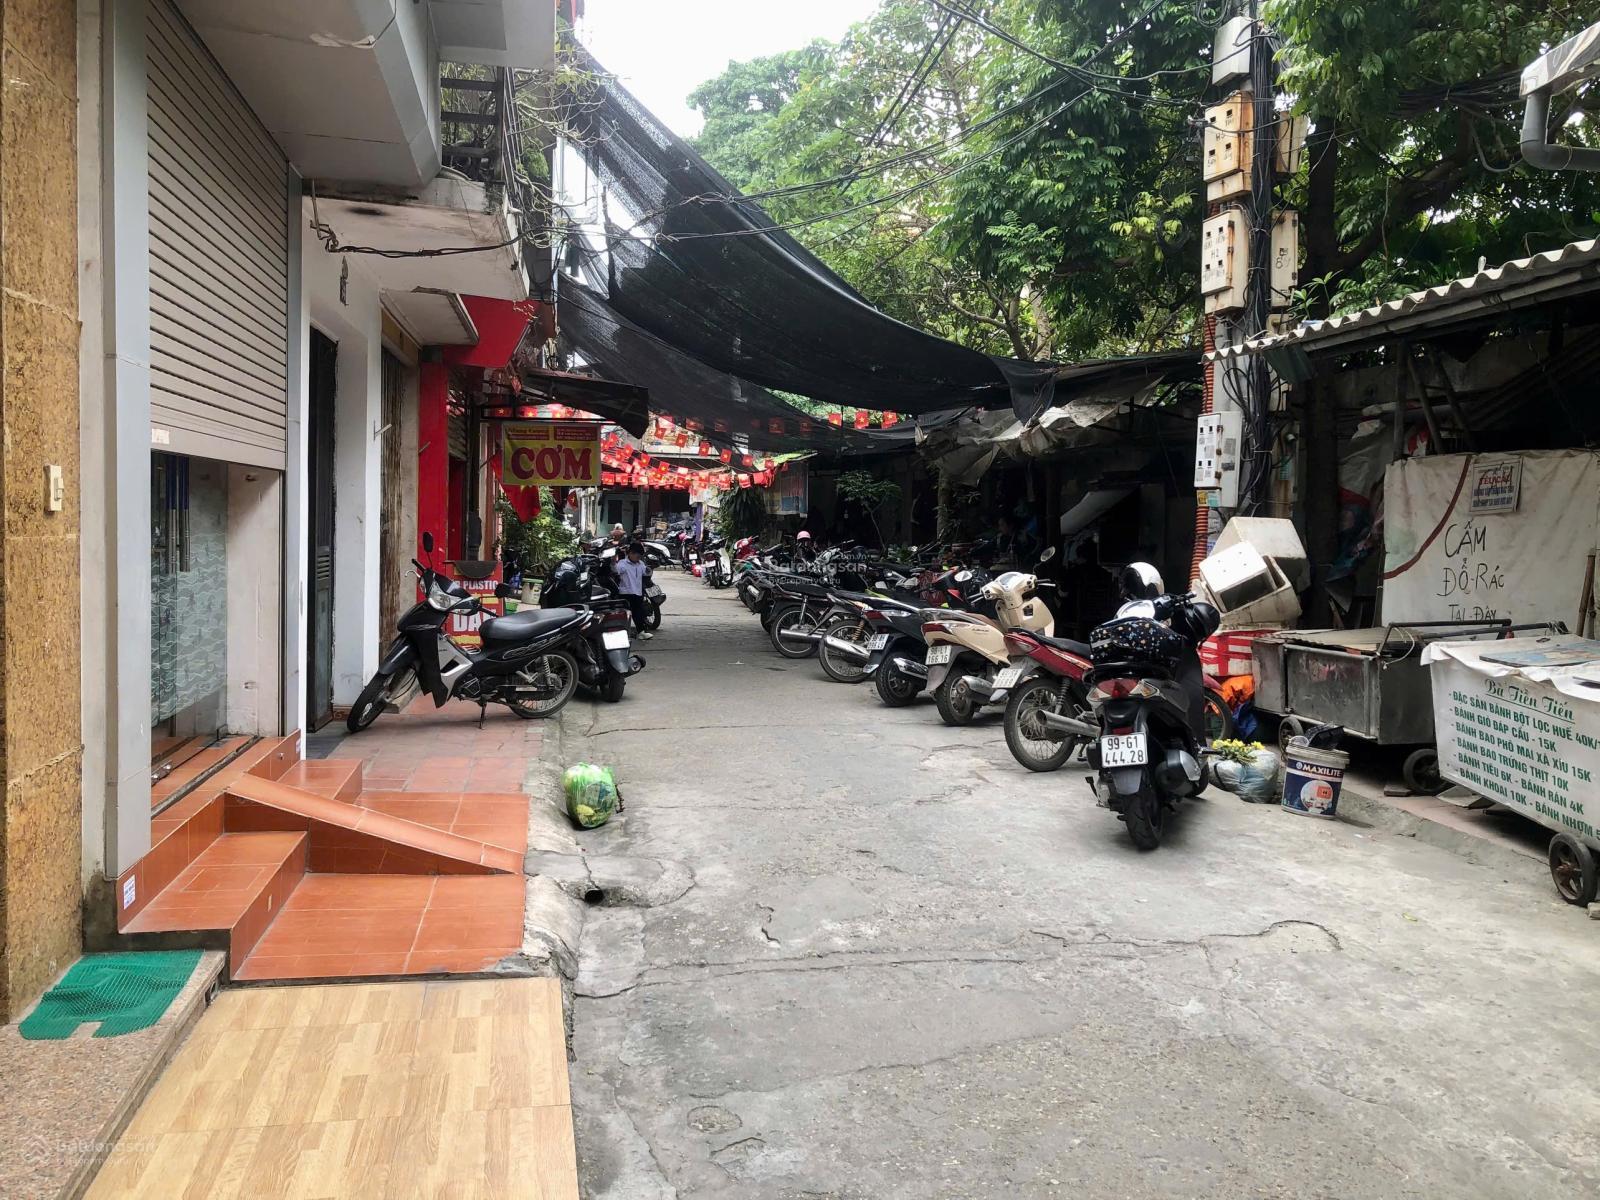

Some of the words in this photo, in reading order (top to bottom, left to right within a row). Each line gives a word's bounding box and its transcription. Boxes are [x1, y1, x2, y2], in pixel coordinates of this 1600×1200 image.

[511, 444, 592, 480] CƠM
[1444, 518, 1487, 558] CẤM
[463, 580, 499, 590] PLASTIC
[1454, 706, 1475, 722] BÁNH
[1538, 737, 1557, 753] 15K
[1489, 702, 1511, 720] BÁNH
[1513, 711, 1530, 727] BỘT
[1532, 718, 1550, 735] LỌC
[1552, 724, 1573, 742] HUẾ
[1104, 750, 1144, 766] 444.28
[1107, 735, 1139, 751] 99-G1
[1456, 721, 1477, 739] BÁNH
[1479, 730, 1496, 745] BAO
[1516, 745, 1534, 760] MAI
[1572, 766, 1592, 784] 15K
[1302, 763, 1342, 778] MAXILITE
[1457, 737, 1478, 755] BÁNH
[1479, 746, 1497, 761] BAO
[1498, 752, 1528, 773] TRỨNG
[1530, 765, 1549, 783] THỊT
[1552, 776, 1569, 792] 10K
[1458, 752, 1480, 770] BÁNH
[1500, 770, 1513, 784] 6K
[1521, 777, 1546, 800] BÁNH
[1548, 791, 1567, 809] RÁN
[1569, 801, 1584, 815] 4K
[1460, 767, 1482, 786] BÁNH
[1483, 778, 1508, 798] KHOAI
[1510, 790, 1528, 806] 10K
[1535, 801, 1560, 821] BÁNH
